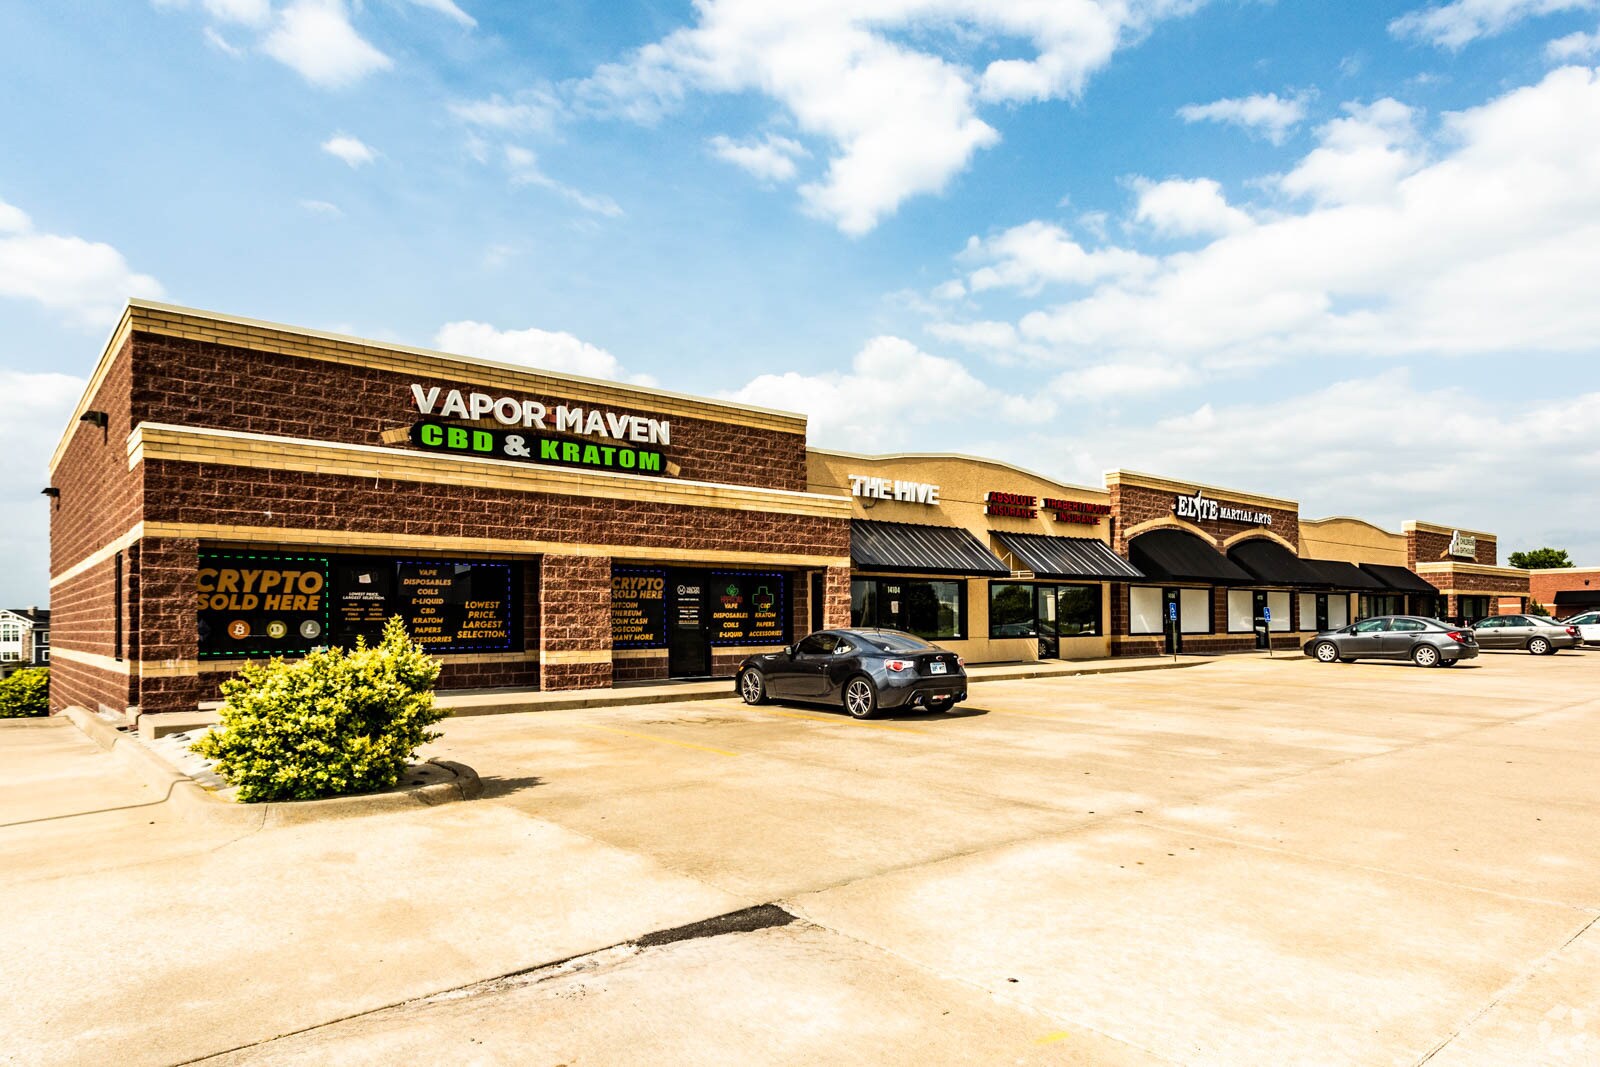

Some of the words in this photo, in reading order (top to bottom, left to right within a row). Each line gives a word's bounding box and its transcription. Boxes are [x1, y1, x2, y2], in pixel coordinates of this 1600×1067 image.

[411, 383, 547, 429] VAPOR
[556, 405, 671, 445] MAVEN
[421, 424, 493, 452] CBD
[503, 434, 531, 458] &
[540, 439, 660, 471] KRATOM
[848, 474, 892, 500] THE
[894, 480, 940, 506] HIVE
[989, 491, 1037, 507] ABSOLUTE
[989, 504, 1038, 519] INSURANCE
[1220, 507, 1253, 522] MARTIAL
[1253, 512, 1272, 525] ARTS
[1059, 513, 1101, 526] INSURANCE
[198, 568, 324, 594] CRYPTO
[403, 578, 452, 586] DISPOSABLES
[611, 576, 664, 590] CRYPTO
[612, 589, 638, 599] SOLD
[639, 590, 663, 599] HERE
[198, 593, 259, 611] SOLD
[264, 594, 321, 611] HERE
[464, 601, 500, 609] LOWEST
[467, 611, 497, 619] PRICE.
[629, 617, 649, 625] CASH
[462, 620, 503, 629] LARGEST
[409, 635, 452, 643] CCESSORIES
[457, 630, 508, 639] SELECTION.
[633, 633, 654, 641] MORE
